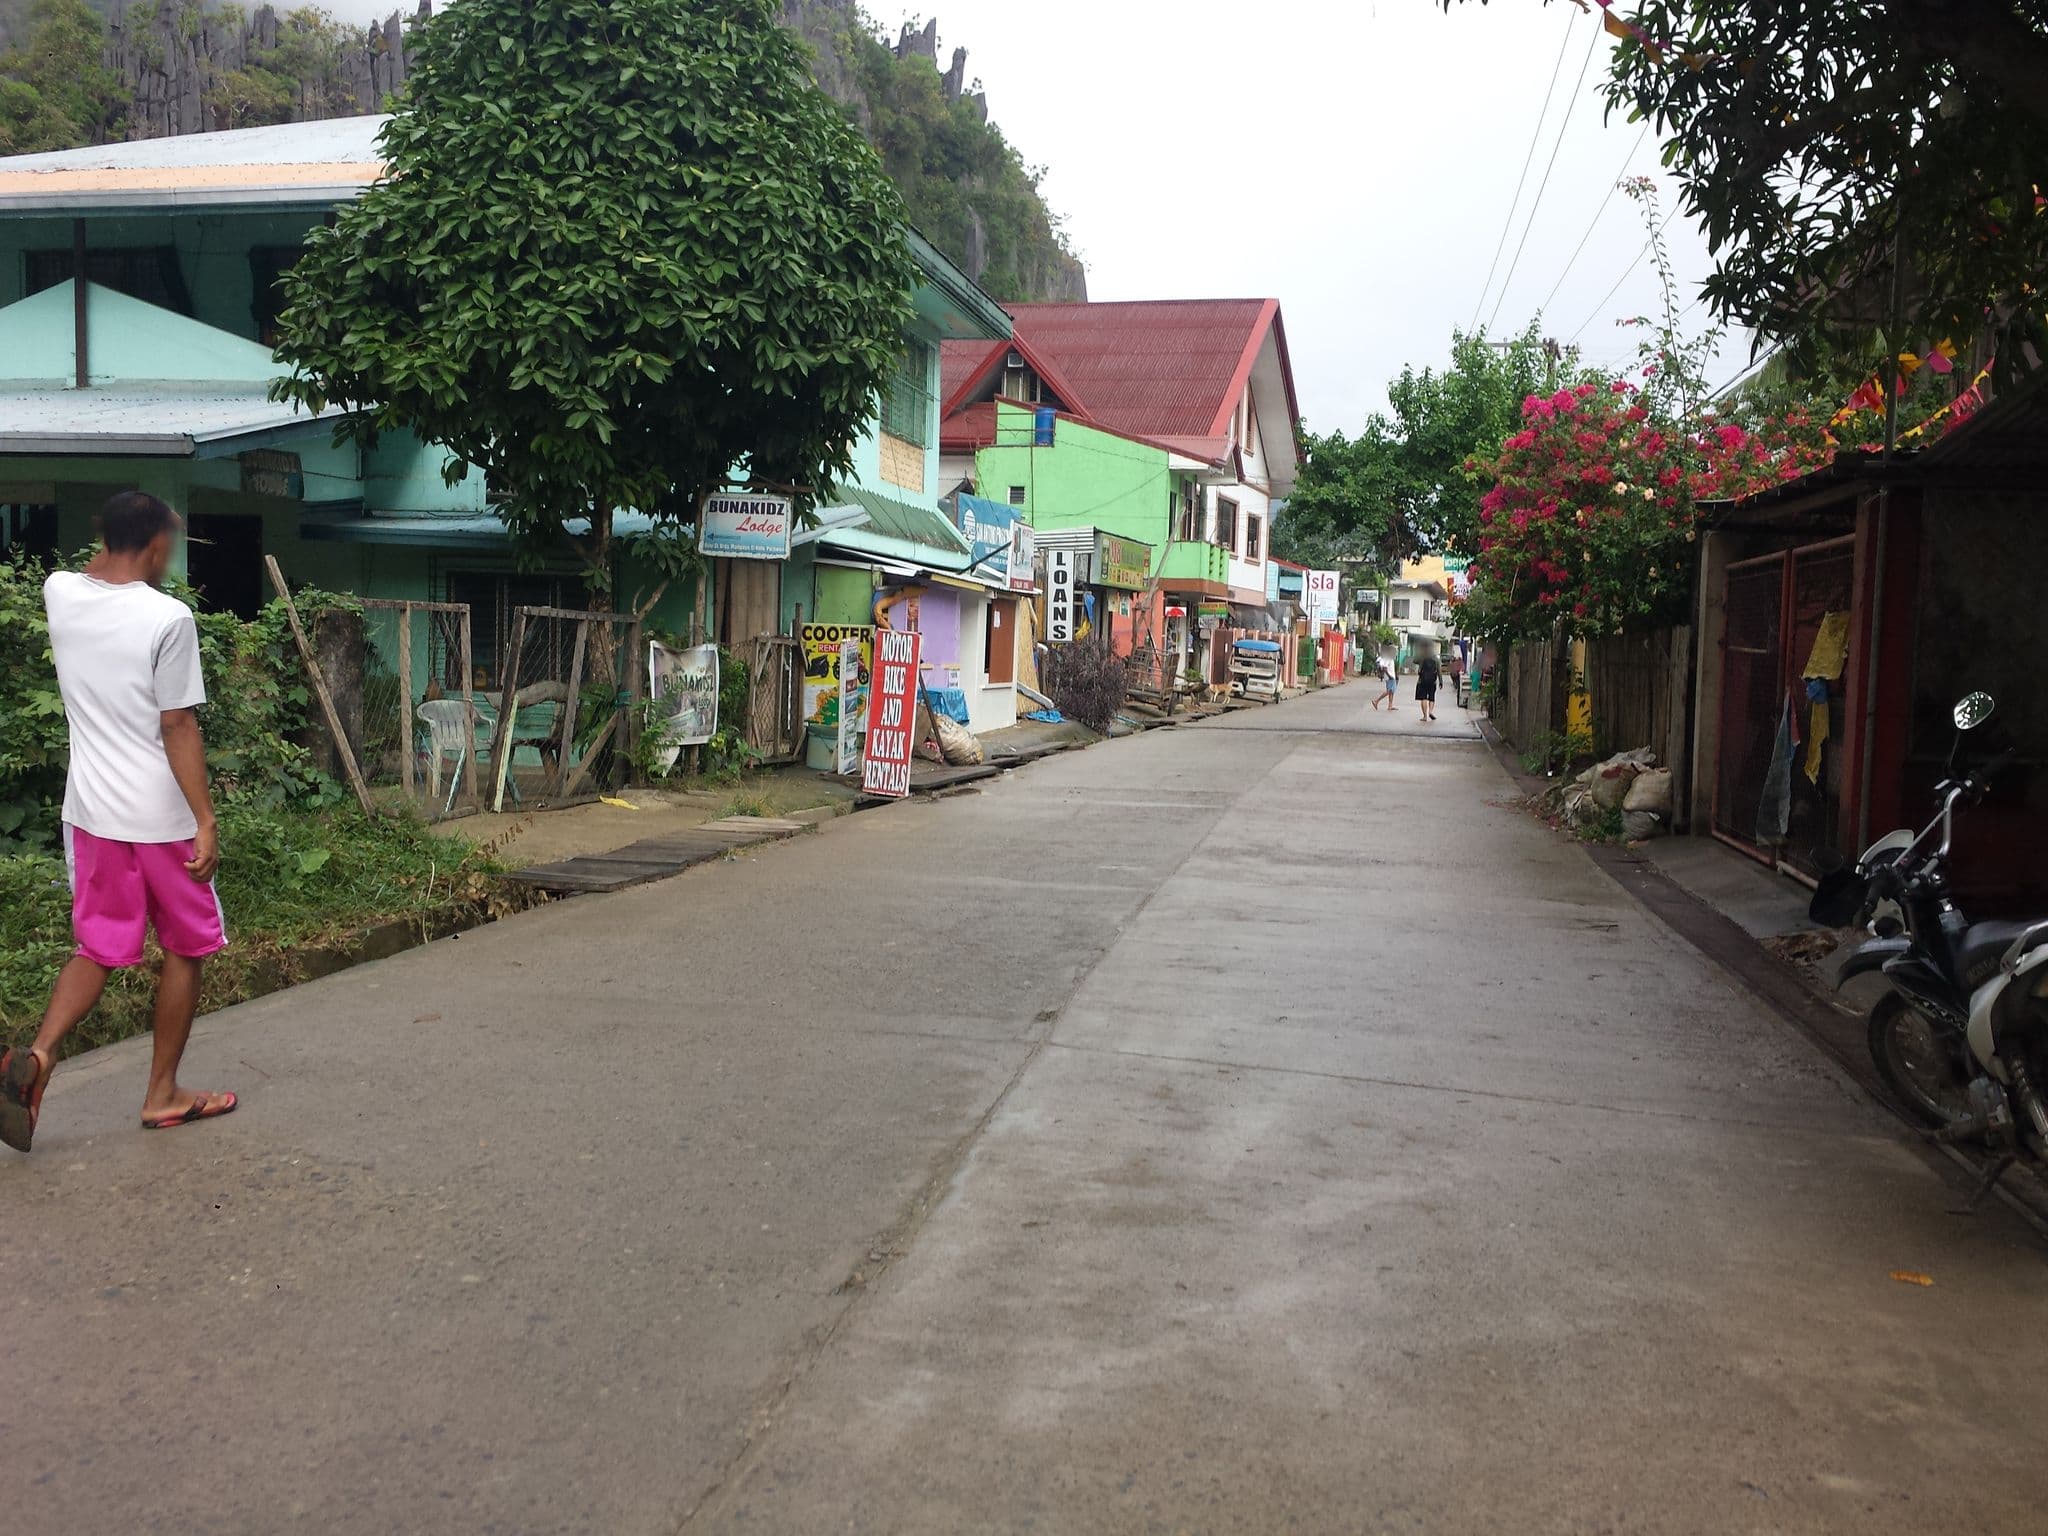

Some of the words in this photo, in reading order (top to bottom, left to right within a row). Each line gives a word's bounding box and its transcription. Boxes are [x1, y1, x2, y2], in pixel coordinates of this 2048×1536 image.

[708, 500, 785, 516] BUNAKIDZ
[735, 515, 783, 538] Lodge
[1052, 551, 1068, 640] LOANS
[801, 624, 871, 643] COOTER
[880, 632, 913, 664] MOTOR
[883, 665, 907, 696] BIKE
[880, 697, 902, 727] AND
[871, 728, 906, 760] KAYAK
[864, 759, 908, 793] RENTALS
